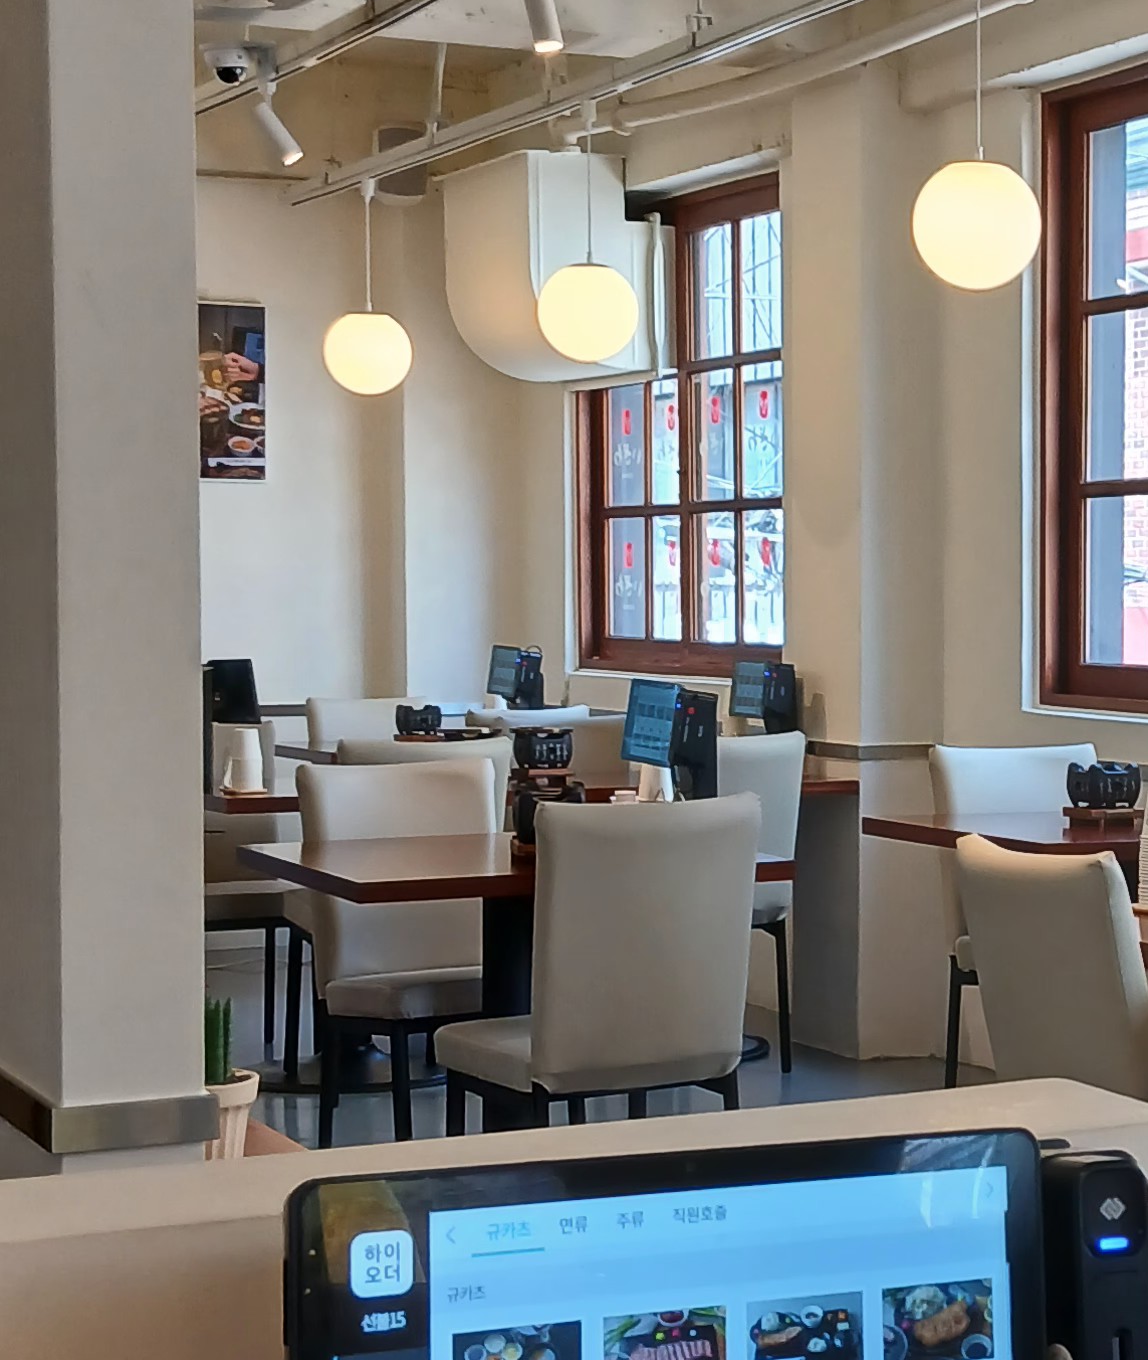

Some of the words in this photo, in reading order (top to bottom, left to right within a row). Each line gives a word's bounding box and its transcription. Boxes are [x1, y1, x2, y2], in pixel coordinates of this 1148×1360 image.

[617, 1210, 645, 1229] 주류
[487, 1221, 532, 1241] 규카츠
[364, 1241, 400, 1262] 하이
[364, 1265, 400, 1284] 오더
[448, 1285, 486, 1303] 규카츠
